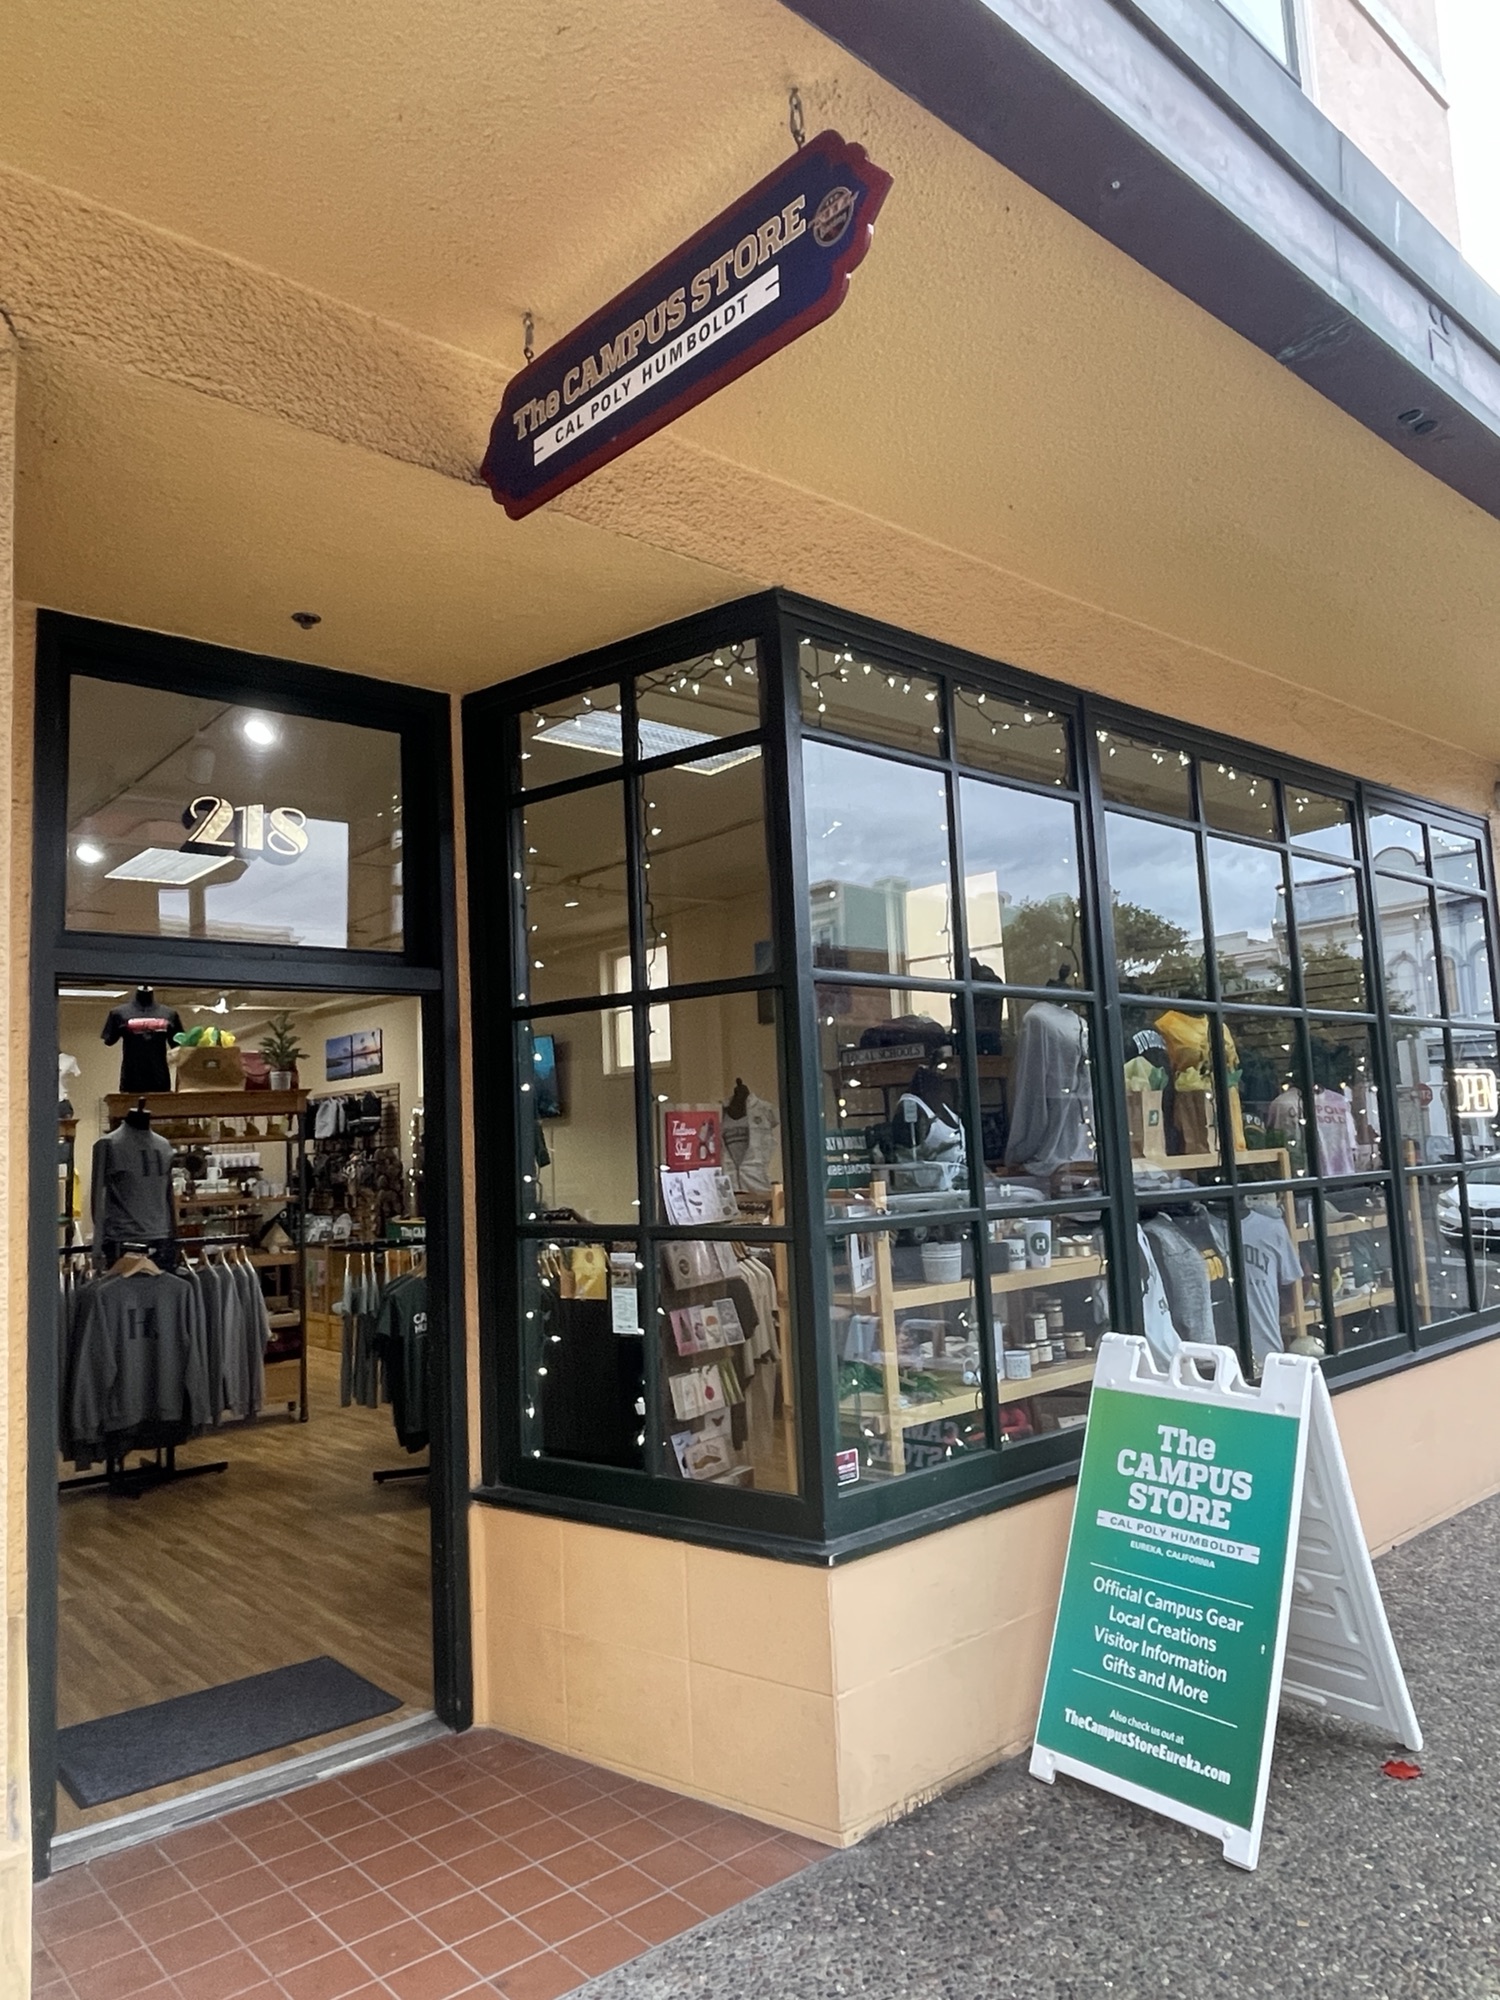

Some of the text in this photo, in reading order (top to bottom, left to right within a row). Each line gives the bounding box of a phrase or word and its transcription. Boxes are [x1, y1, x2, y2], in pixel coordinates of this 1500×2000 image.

[512, 389, 560, 441] The
[562, 286, 686, 405] CAMPUS
[690, 193, 807, 313] STORE
[554, 293, 749, 443] CAL POLY HUMBOLDT
[181, 795, 309, 857] 218
[878, 1045, 921, 1060] SCHOOLS
[1000, 1184, 1012, 1197] H
[1035, 1238, 1046, 1250] H
[1245, 1243, 1270, 1275] OLY
[1157, 1424, 1216, 1461] The
[1117, 1448, 1253, 1500] CAMPUS
[1127, 1482, 1232, 1531] STORE
[1109, 1516, 1244, 1557] CAL POLY HUMBOLDT
[1130, 1540, 1216, 1569] EUREKA, CALIFORNIA
[1093, 1576, 1244, 1633] Official Campus Gear
[1108, 1605, 1217, 1652] Local Creations
[1094, 1625, 1228, 1683] Visitor Information
[1102, 1653, 1209, 1704] Gifts and More
[1064, 1707, 1232, 1786] TheCampusStoreEureka.com
[1109, 1709, 1185, 1745] Also check us out at
